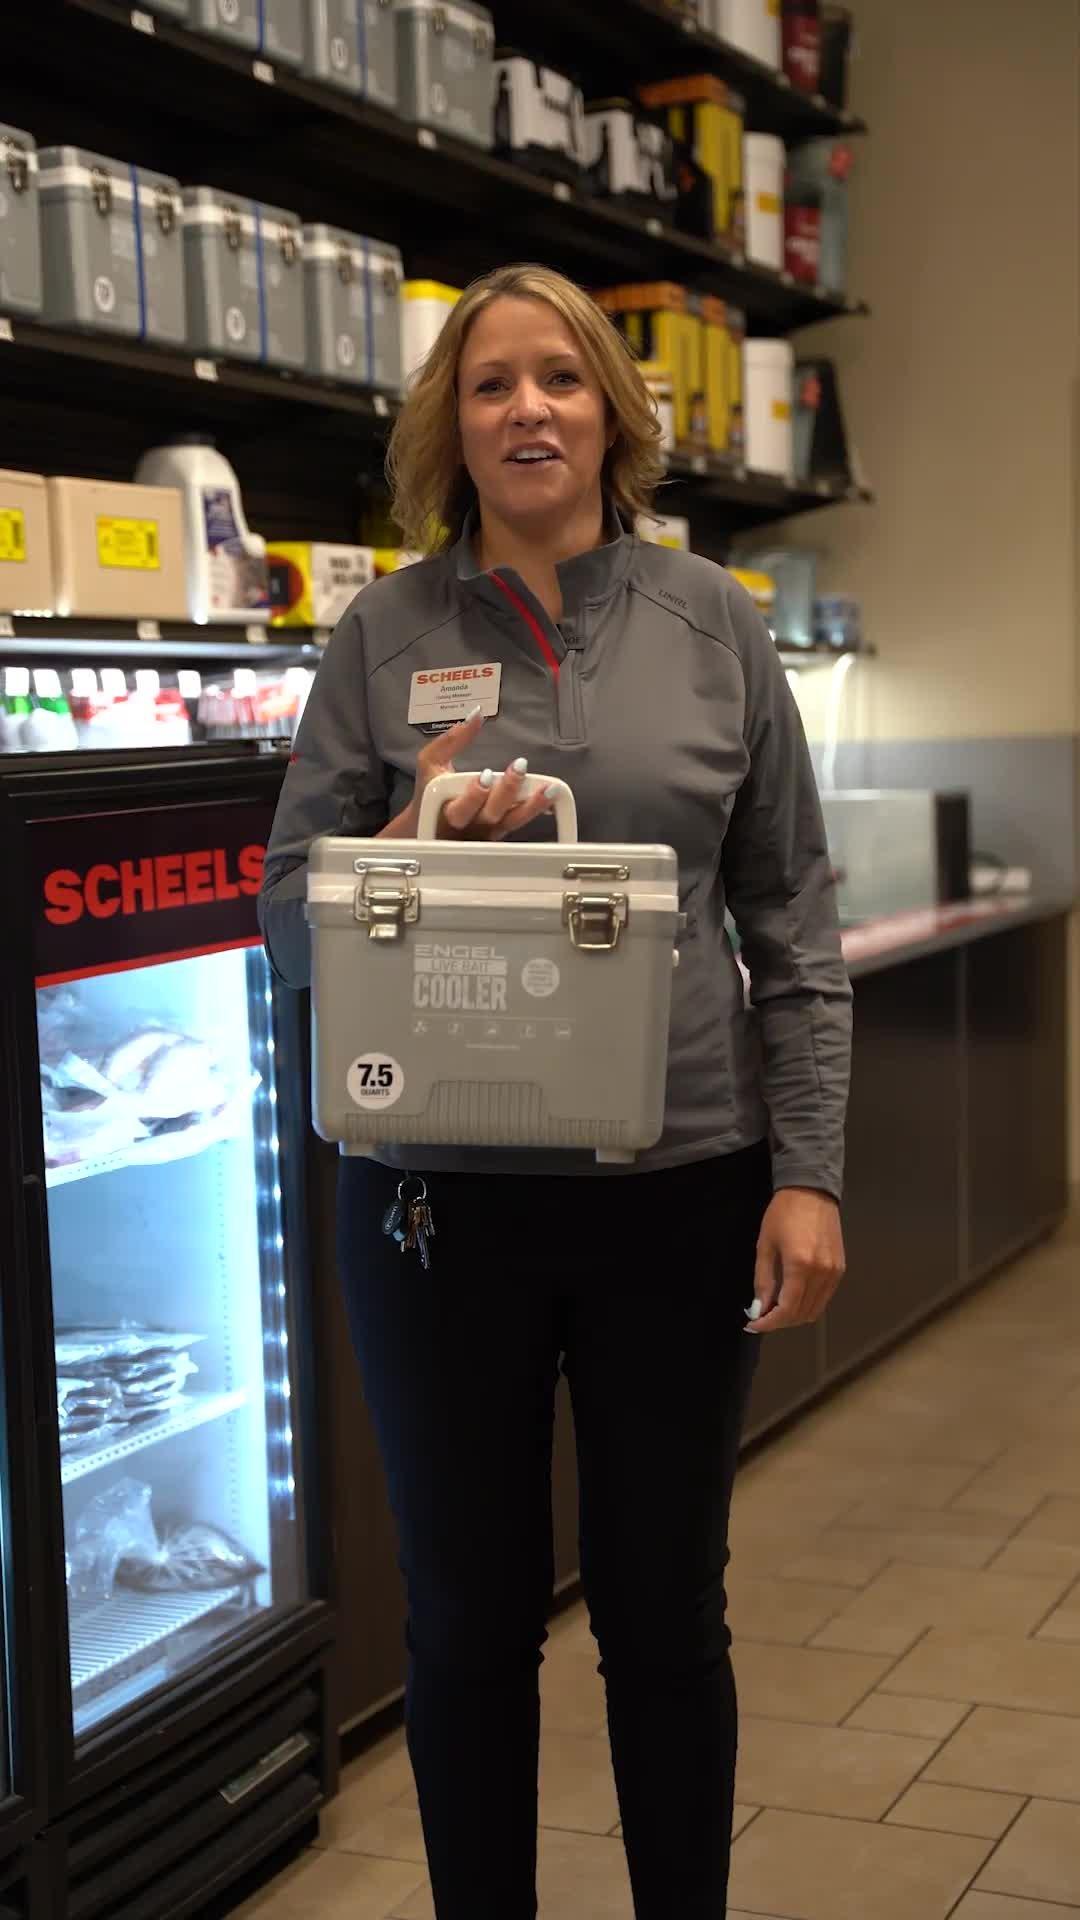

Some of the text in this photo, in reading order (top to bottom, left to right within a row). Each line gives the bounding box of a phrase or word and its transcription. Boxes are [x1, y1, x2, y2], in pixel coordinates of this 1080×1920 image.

[416, 667, 494, 685] SCHEELS
[440, 684, 468, 692] Amanda
[44, 844, 268, 926] SCHEELS
[415, 944, 505, 959] ENGEL
[431, 960, 489, 974] LIVE BAIT
[414, 974, 507, 1011] COOLER
[357, 1063, 393, 1087] 7.5
[360, 1088, 391, 1097] QUARTS
